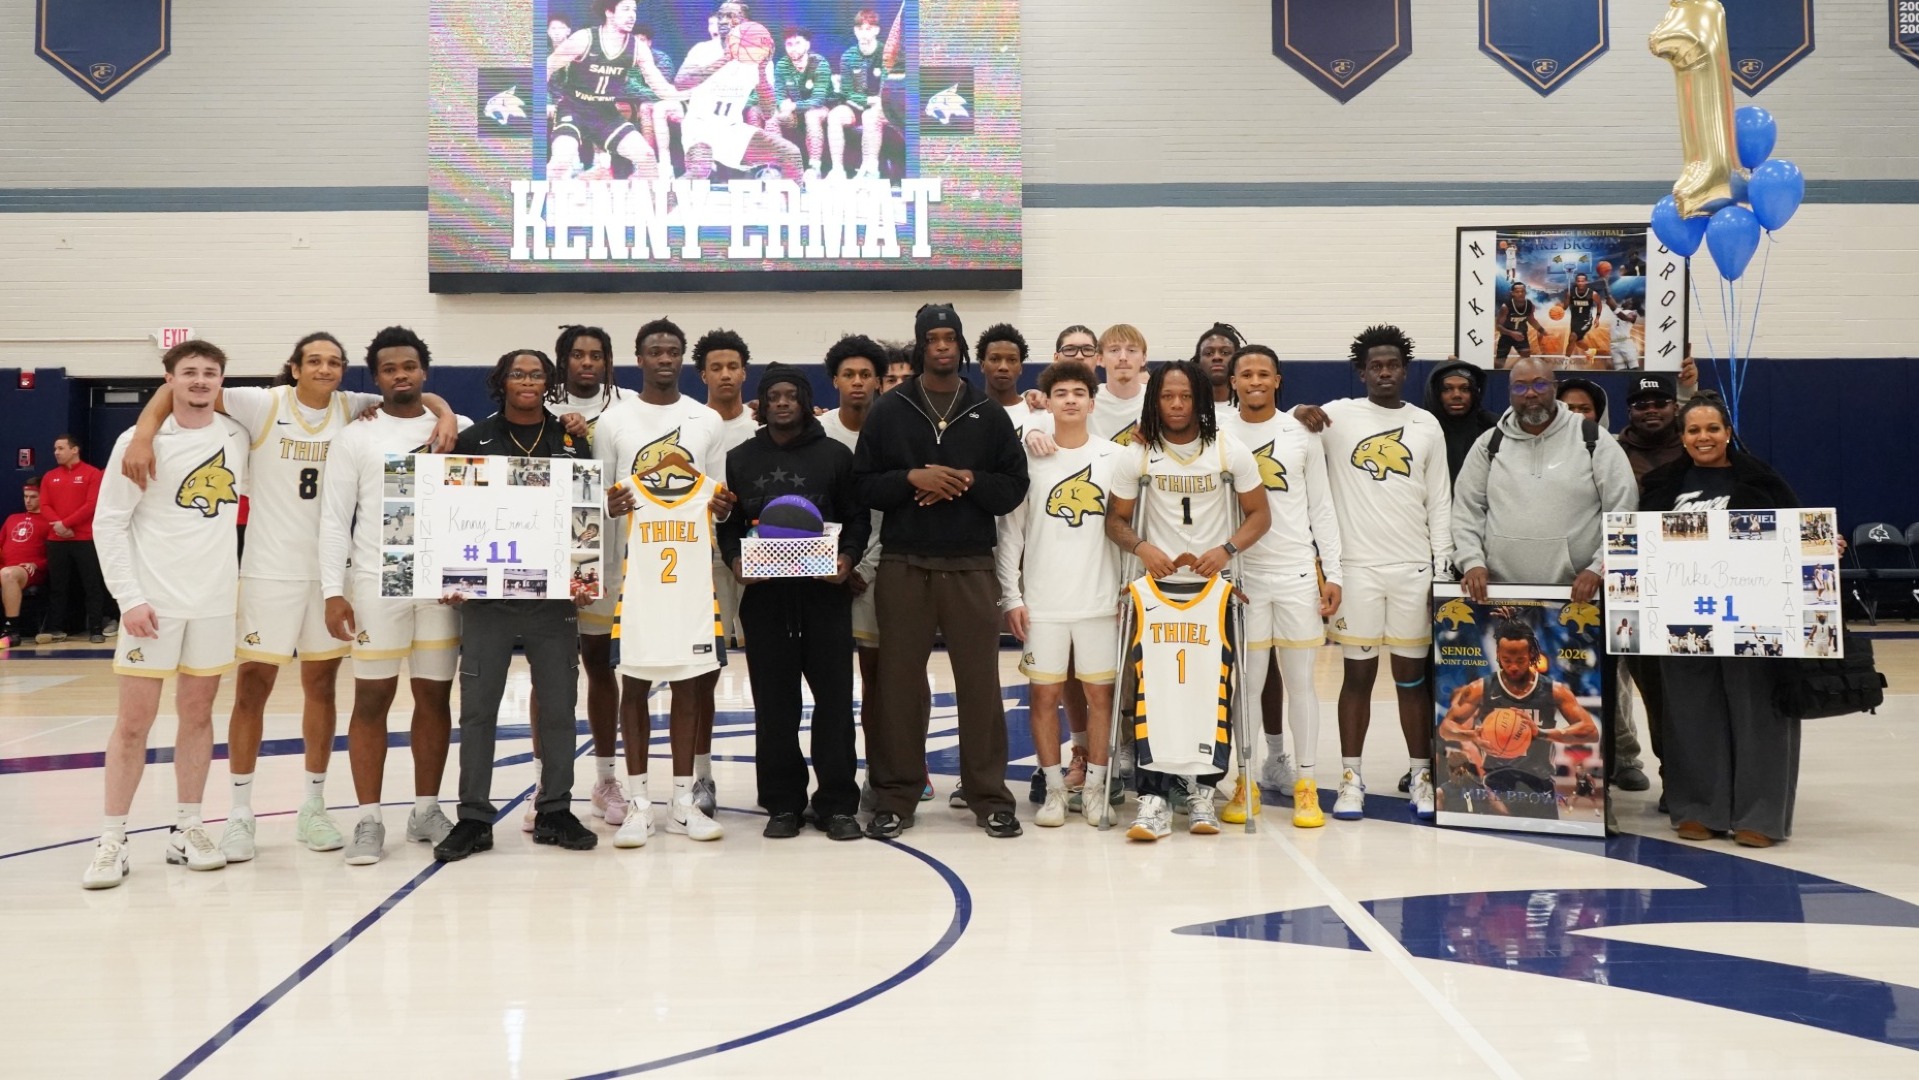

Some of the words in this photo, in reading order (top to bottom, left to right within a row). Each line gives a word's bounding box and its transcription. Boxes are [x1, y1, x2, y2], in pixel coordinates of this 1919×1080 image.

[589, 64, 624, 75] SAINT
[594, 76, 609, 94] 11
[713, 101, 732, 116] 11
[510, 179, 710, 259] KENNY
[1576, 229, 1625, 237] BASKETBALL
[1467, 241, 1485, 346] MIKE
[163, 328, 189, 348] EXIT
[279, 437, 330, 462] THIE
[299, 467, 319, 500] 8
[1155, 473, 1217, 494] THIEL
[1181, 496, 1193, 525] 1
[1741, 514, 1777, 524] TIEL
[419, 473, 436, 586] SENIOR
[448, 505, 491, 544] Kenny
[638, 519, 699, 544] THIEL
[660, 547, 678, 584] 2
[1666, 560, 1711, 588] Mike
[1711, 560, 1773, 589] Brown
[1644, 530, 1660, 640] SENIOR
[1782, 526, 1797, 642] CAPTAIN
[1693, 595, 1740, 622] #1
[1150, 622, 1211, 646] THIEL
[1439, 658, 1461, 666] POINT
[1462, 659, 1489, 667] GUARD
[1441, 646, 1482, 657] SENIOR
[1557, 648, 1588, 660] 2026
[1176, 648, 1186, 685] 1
